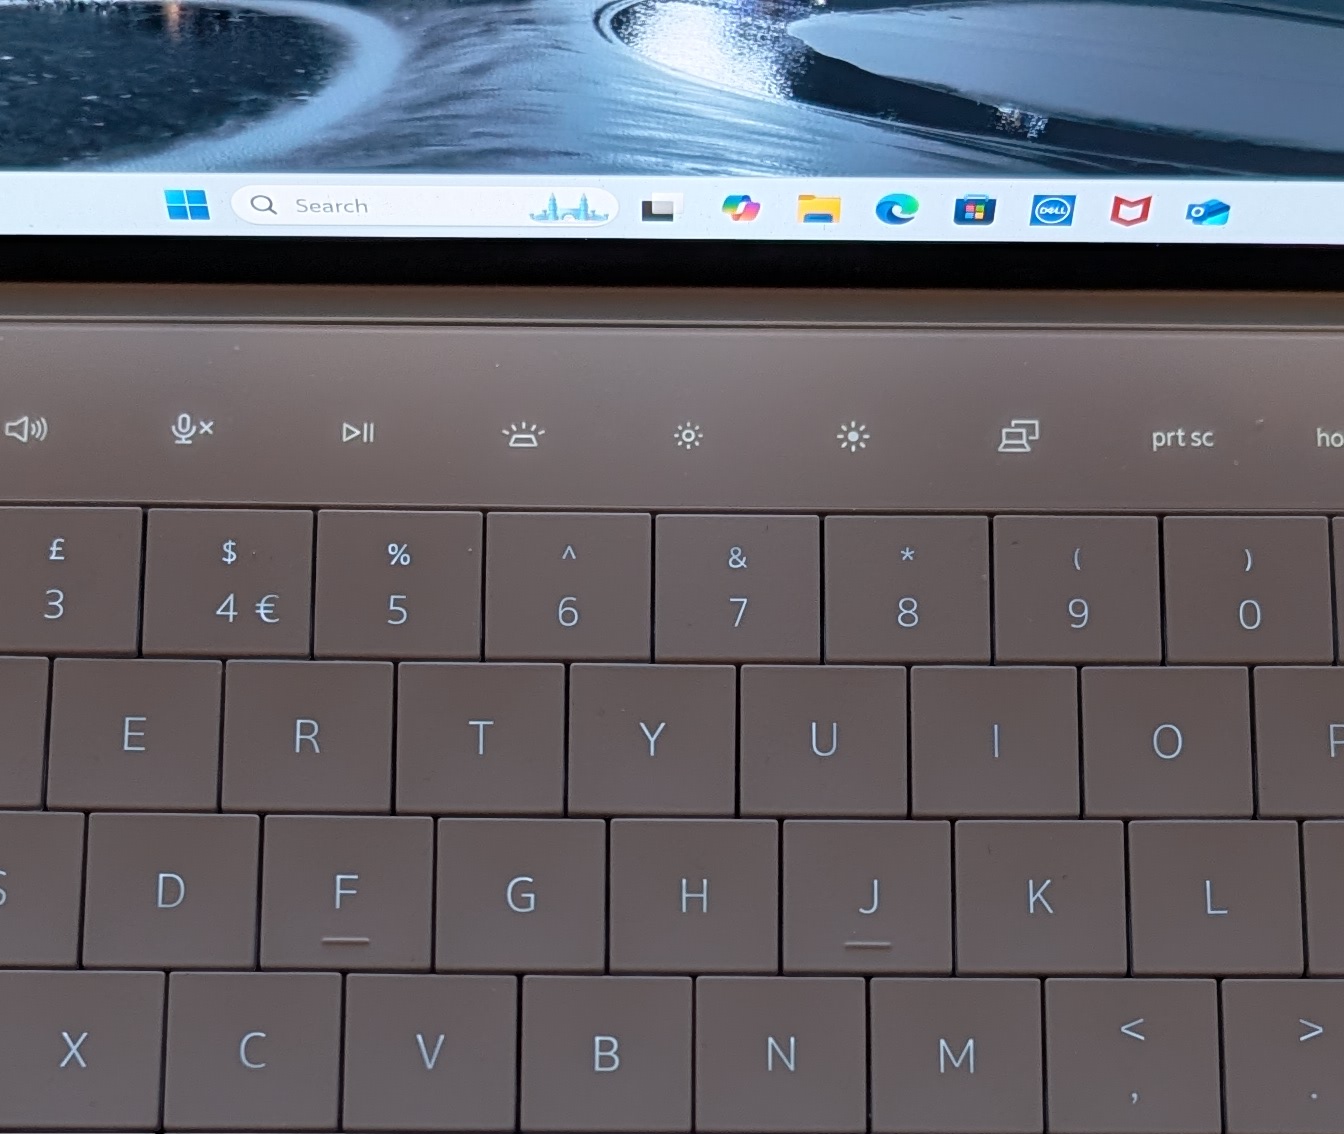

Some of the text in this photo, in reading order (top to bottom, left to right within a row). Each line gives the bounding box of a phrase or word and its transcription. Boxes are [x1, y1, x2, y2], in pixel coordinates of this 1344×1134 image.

[295, 198, 368, 213] Search
[1152, 428, 1214, 452] prt sc
[49, 538, 65, 560] £
[221, 539, 237, 565] $
[387, 543, 411, 566] %
[728, 546, 748, 569] &
[43, 589, 64, 619] 3
[215, 593, 280, 623] 4 €
[387, 594, 408, 625] 5
[558, 596, 579, 627] 6
[729, 597, 748, 628] 7
[897, 597, 919, 628] 8
[1068, 598, 1089, 629] 9
[123, 716, 147, 751] E
[295, 719, 320, 754] R
[468, 720, 494, 755] T
[639, 722, 666, 757] Y
[811, 721, 837, 757] U
[157, 873, 185, 908] D
[335, 874, 359, 909] F
[506, 876, 535, 913] G
[681, 878, 708, 913] H
[858, 879, 878, 914] J
[1028, 879, 1054, 914] K
[1205, 879, 1228, 915] L
[59, 1031, 88, 1068] X
[239, 1031, 267, 1069] C
[416, 1033, 445, 1070] V
[594, 1035, 620, 1072] B
[767, 1036, 795, 1072] N
[939, 1038, 974, 1074] M
